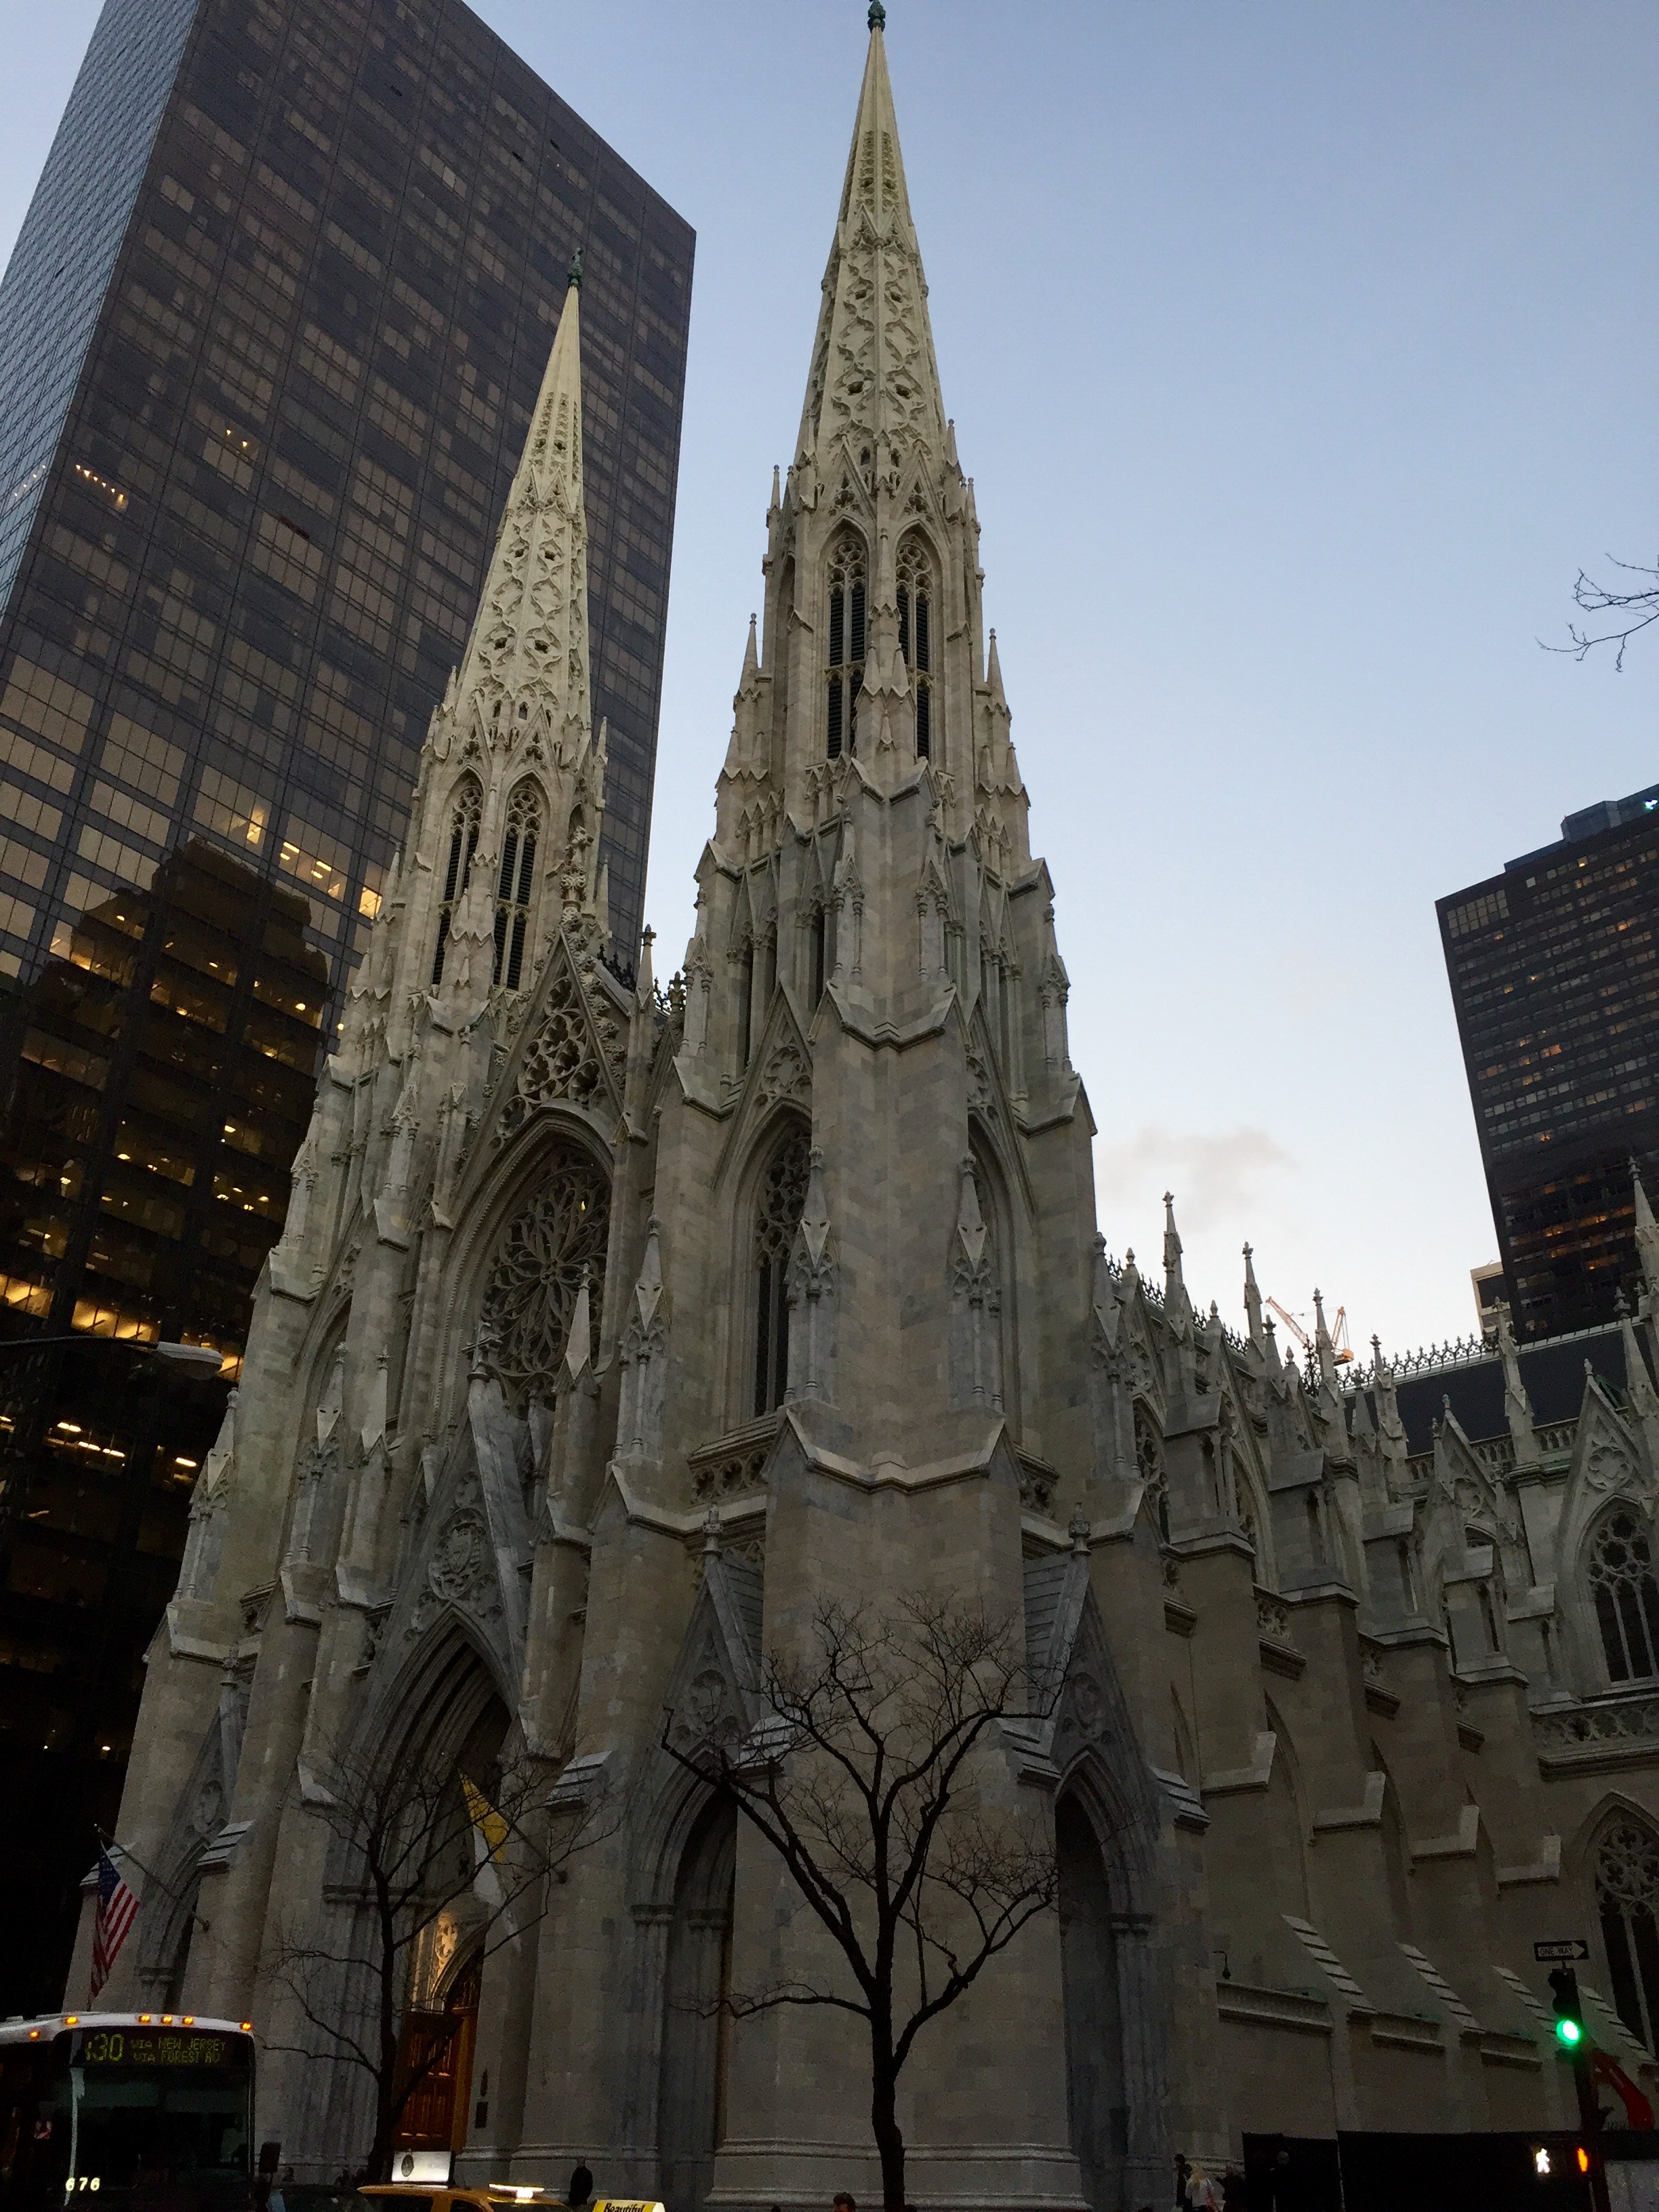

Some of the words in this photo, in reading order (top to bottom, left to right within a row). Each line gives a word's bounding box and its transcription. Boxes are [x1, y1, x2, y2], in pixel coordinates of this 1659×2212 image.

[1540, 1947, 1554, 1956] ONE
[1557, 1946, 1572, 1954] WAY
[130, 2039, 152, 2049] VIA
[158, 2037, 182, 2050] NEW
[134, 2052, 156, 2063] VIA
[161, 2050, 201, 2064] FOREST
[65, 2177, 100, 2191] 676
